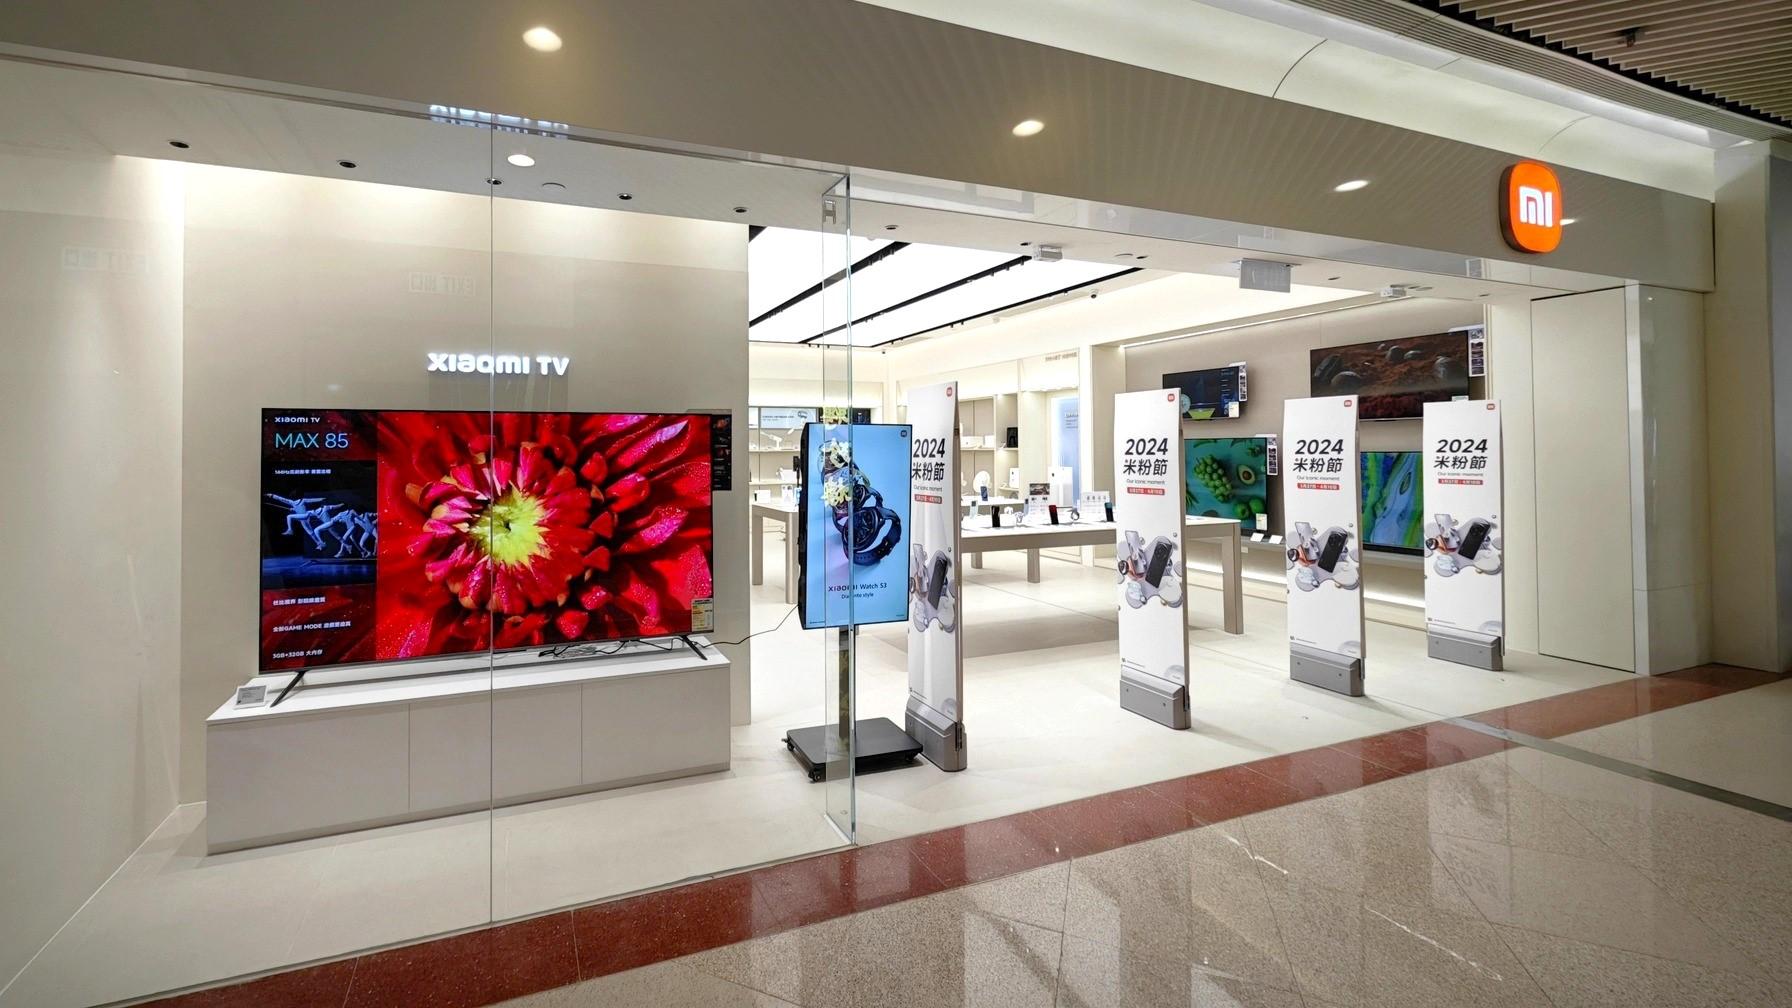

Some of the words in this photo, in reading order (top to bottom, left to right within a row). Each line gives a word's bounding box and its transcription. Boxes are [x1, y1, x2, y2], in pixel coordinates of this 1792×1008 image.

[536, 355, 570, 376] TV
[275, 433, 320, 449] MAX
[325, 432, 349, 449] 85
[913, 438, 946, 458] 2024
[1125, 438, 1168, 455] 2024
[1295, 439, 1344, 454] 2024
[1436, 439, 1488, 453] 2024
[911, 462, 945, 481] 米粉節
[1123, 459, 1168, 476] 米粉節
[1293, 458, 1344, 473] 米粉節
[1433, 456, 1488, 470] 米粉節
